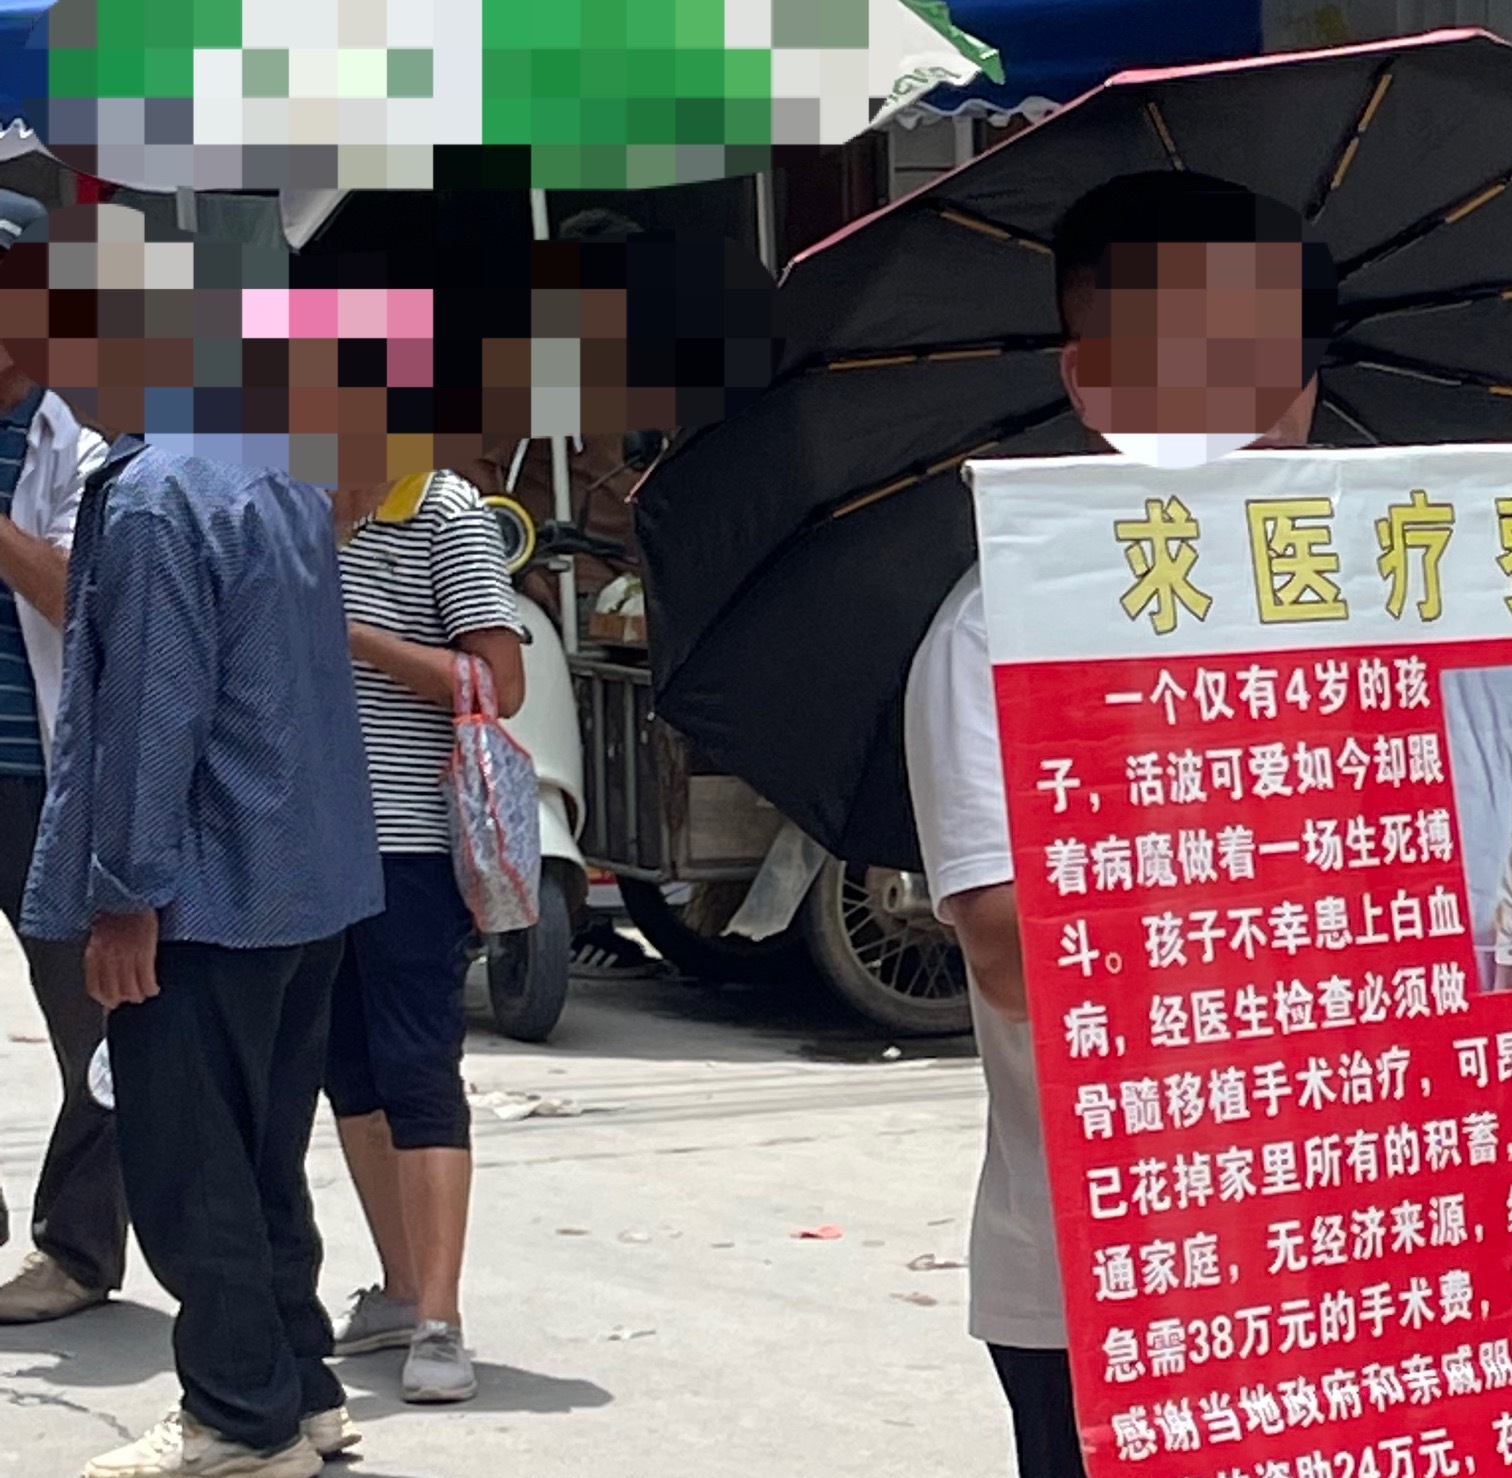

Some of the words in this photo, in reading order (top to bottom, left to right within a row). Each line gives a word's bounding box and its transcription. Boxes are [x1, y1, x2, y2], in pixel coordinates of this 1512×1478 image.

[1105, 656, 1430, 724] 一个仅有4岁的孩
[1045, 809, 1453, 895] 着病魔做着一场生死搏
[1059, 886, 1464, 976] 斗。孩子不幸患上白血
[1064, 962, 1468, 1057] 病，经医生检查必须做
